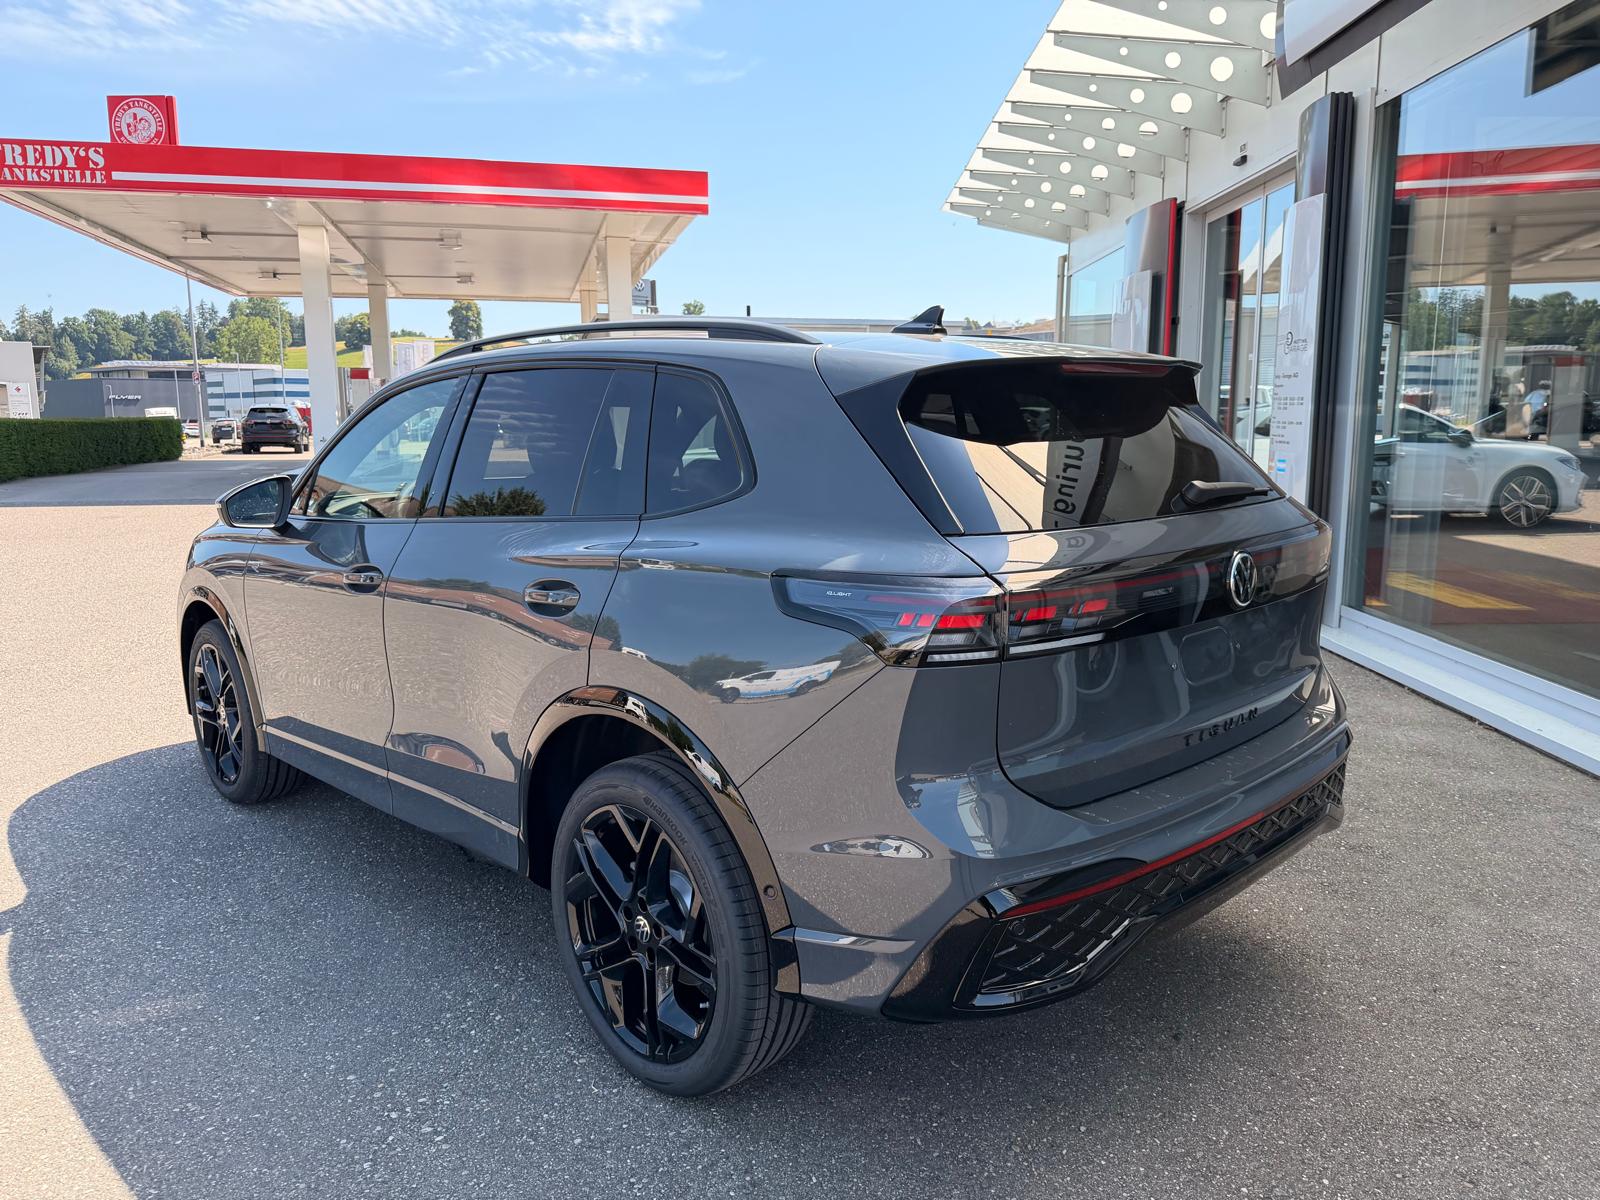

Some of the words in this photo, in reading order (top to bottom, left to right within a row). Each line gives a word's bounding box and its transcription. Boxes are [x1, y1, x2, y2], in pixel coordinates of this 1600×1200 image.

[129, 100, 162, 132] TANKSTELLE
[0, 143, 105, 169] REDY‘S
[0, 167, 106, 184] ANKSTELLE
[1184, 707, 1258, 747] TIGUAN
